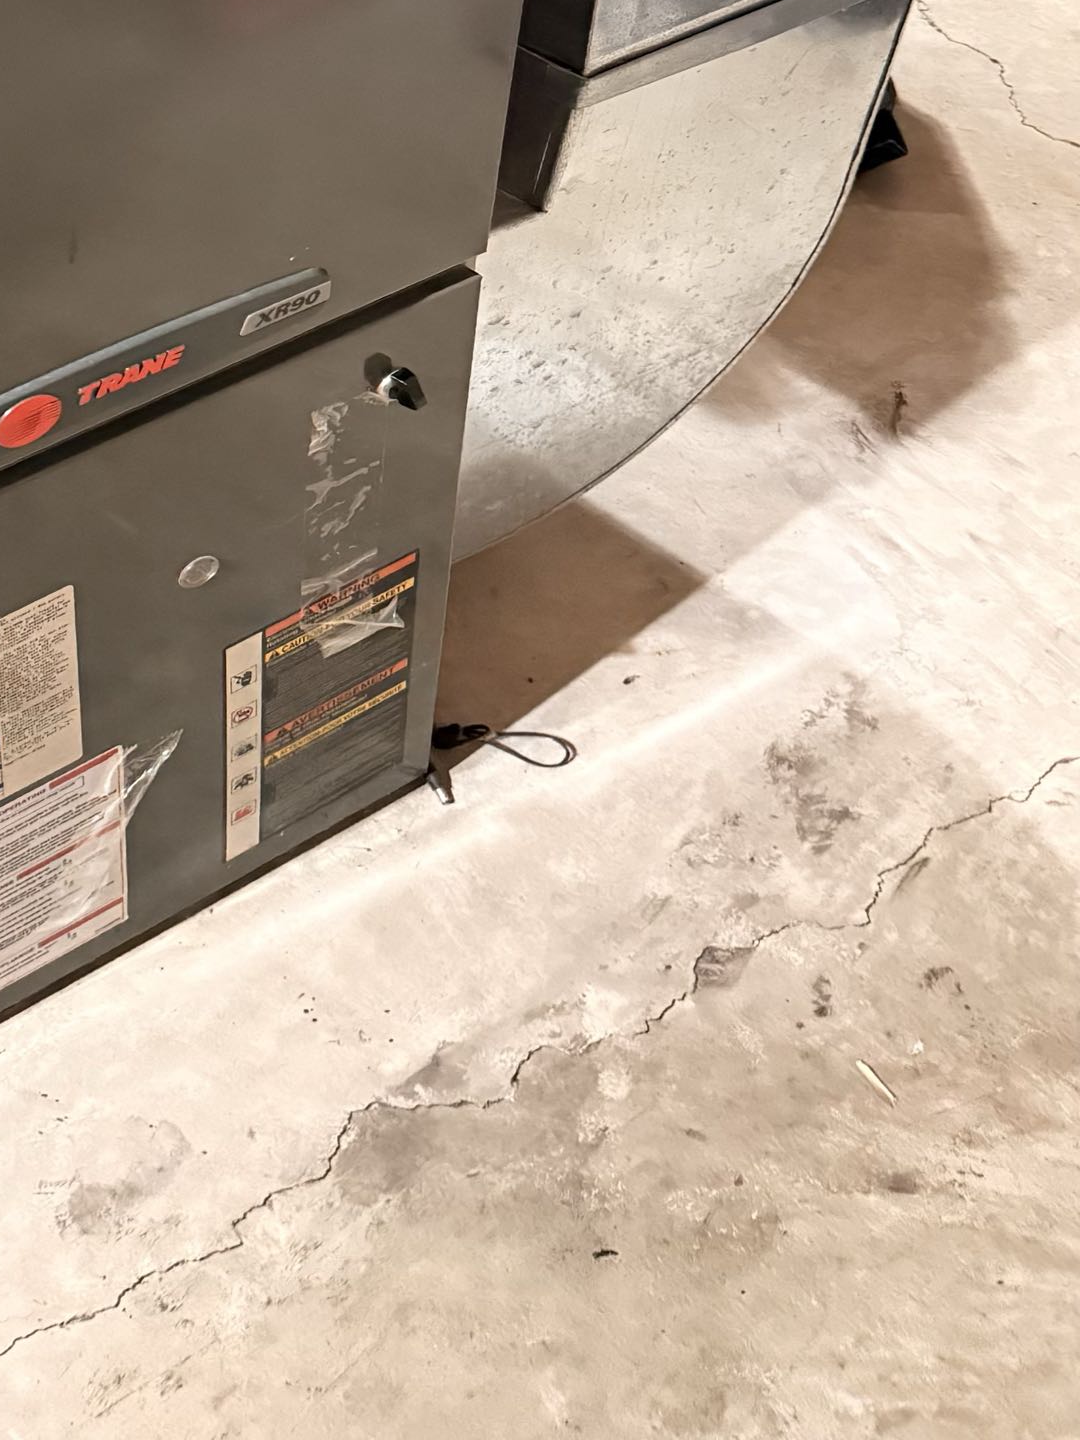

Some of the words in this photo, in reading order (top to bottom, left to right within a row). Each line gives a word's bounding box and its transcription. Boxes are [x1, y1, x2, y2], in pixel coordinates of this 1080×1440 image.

[255, 288, 322, 329] XR90
[77, 344, 186, 407] TRANE
[317, 573, 381, 610] WARNING
[372, 582, 407, 605] SAFETY
[291, 667, 394, 728] AVERTISSEMENT
